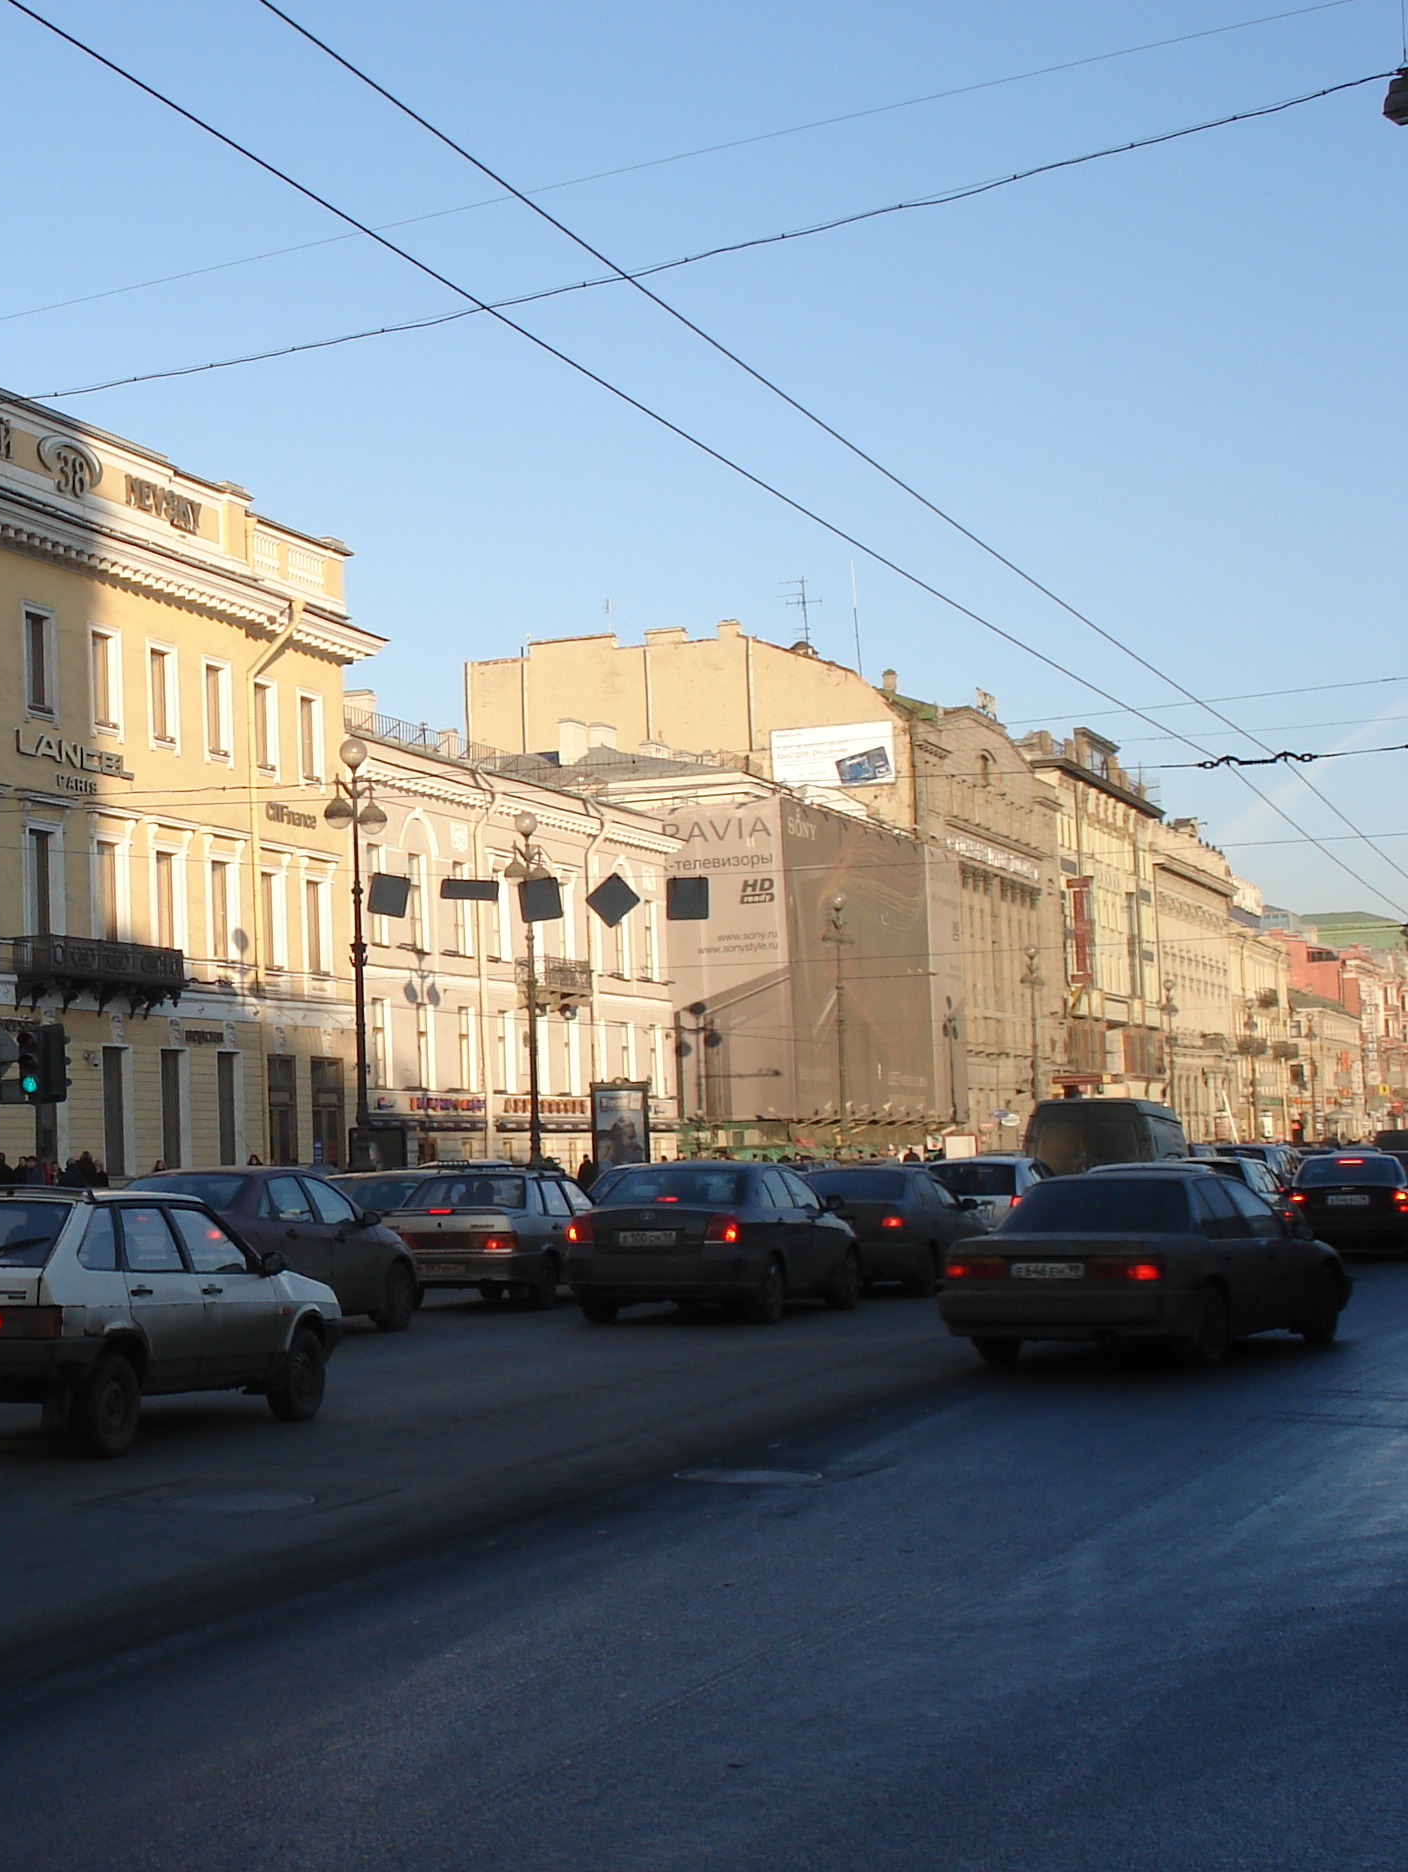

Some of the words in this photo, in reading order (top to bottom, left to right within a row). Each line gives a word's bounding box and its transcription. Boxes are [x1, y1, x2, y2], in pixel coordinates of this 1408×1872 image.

[55, 449, 88, 499] 38
[125, 473, 203, 536] NEVSKY
[13, 727, 135, 781] LANCEL
[55, 771, 98, 795] PARIS
[787, 815, 817, 841] SONY
[742, 877, 774, 894] HD
[743, 893, 772, 903] ready
[697, 942, 778, 955] www.sonystyle.ru
[717, 930, 778, 943] www.sony.ru
